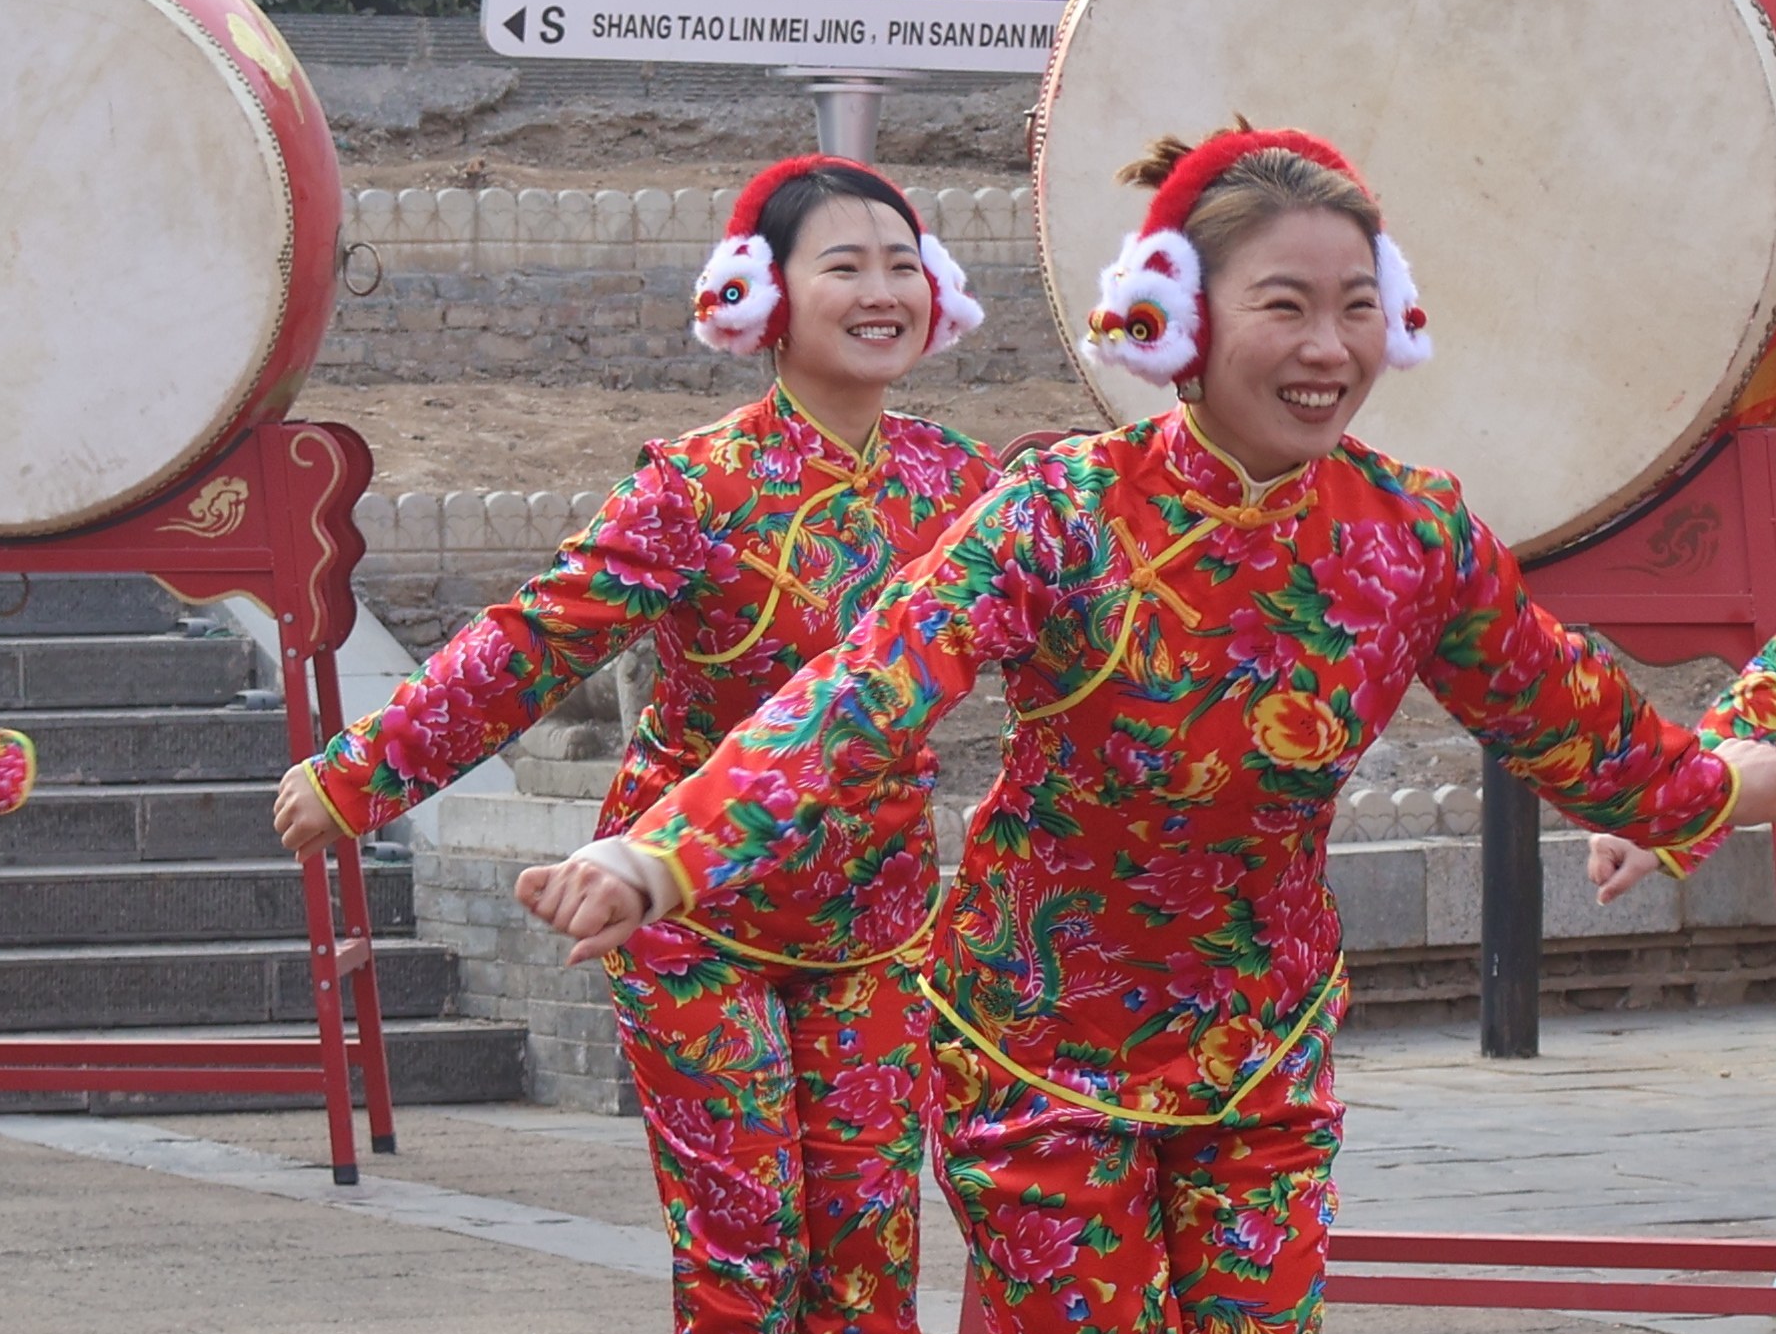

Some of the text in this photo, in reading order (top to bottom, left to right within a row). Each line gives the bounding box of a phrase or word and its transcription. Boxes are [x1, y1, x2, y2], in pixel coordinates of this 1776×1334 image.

[540, 5, 565, 44] S
[592, 13, 672, 39] SHANG
[677, 15, 724, 40] TAO
[729, 17, 765, 42] LIN
[769, 18, 809, 43] MEI
[888, 21, 924, 46] PIN
[929, 22, 974, 47] SAN
[980, 24, 1025, 49] DAN
[1030, 24, 1057, 49] MI
